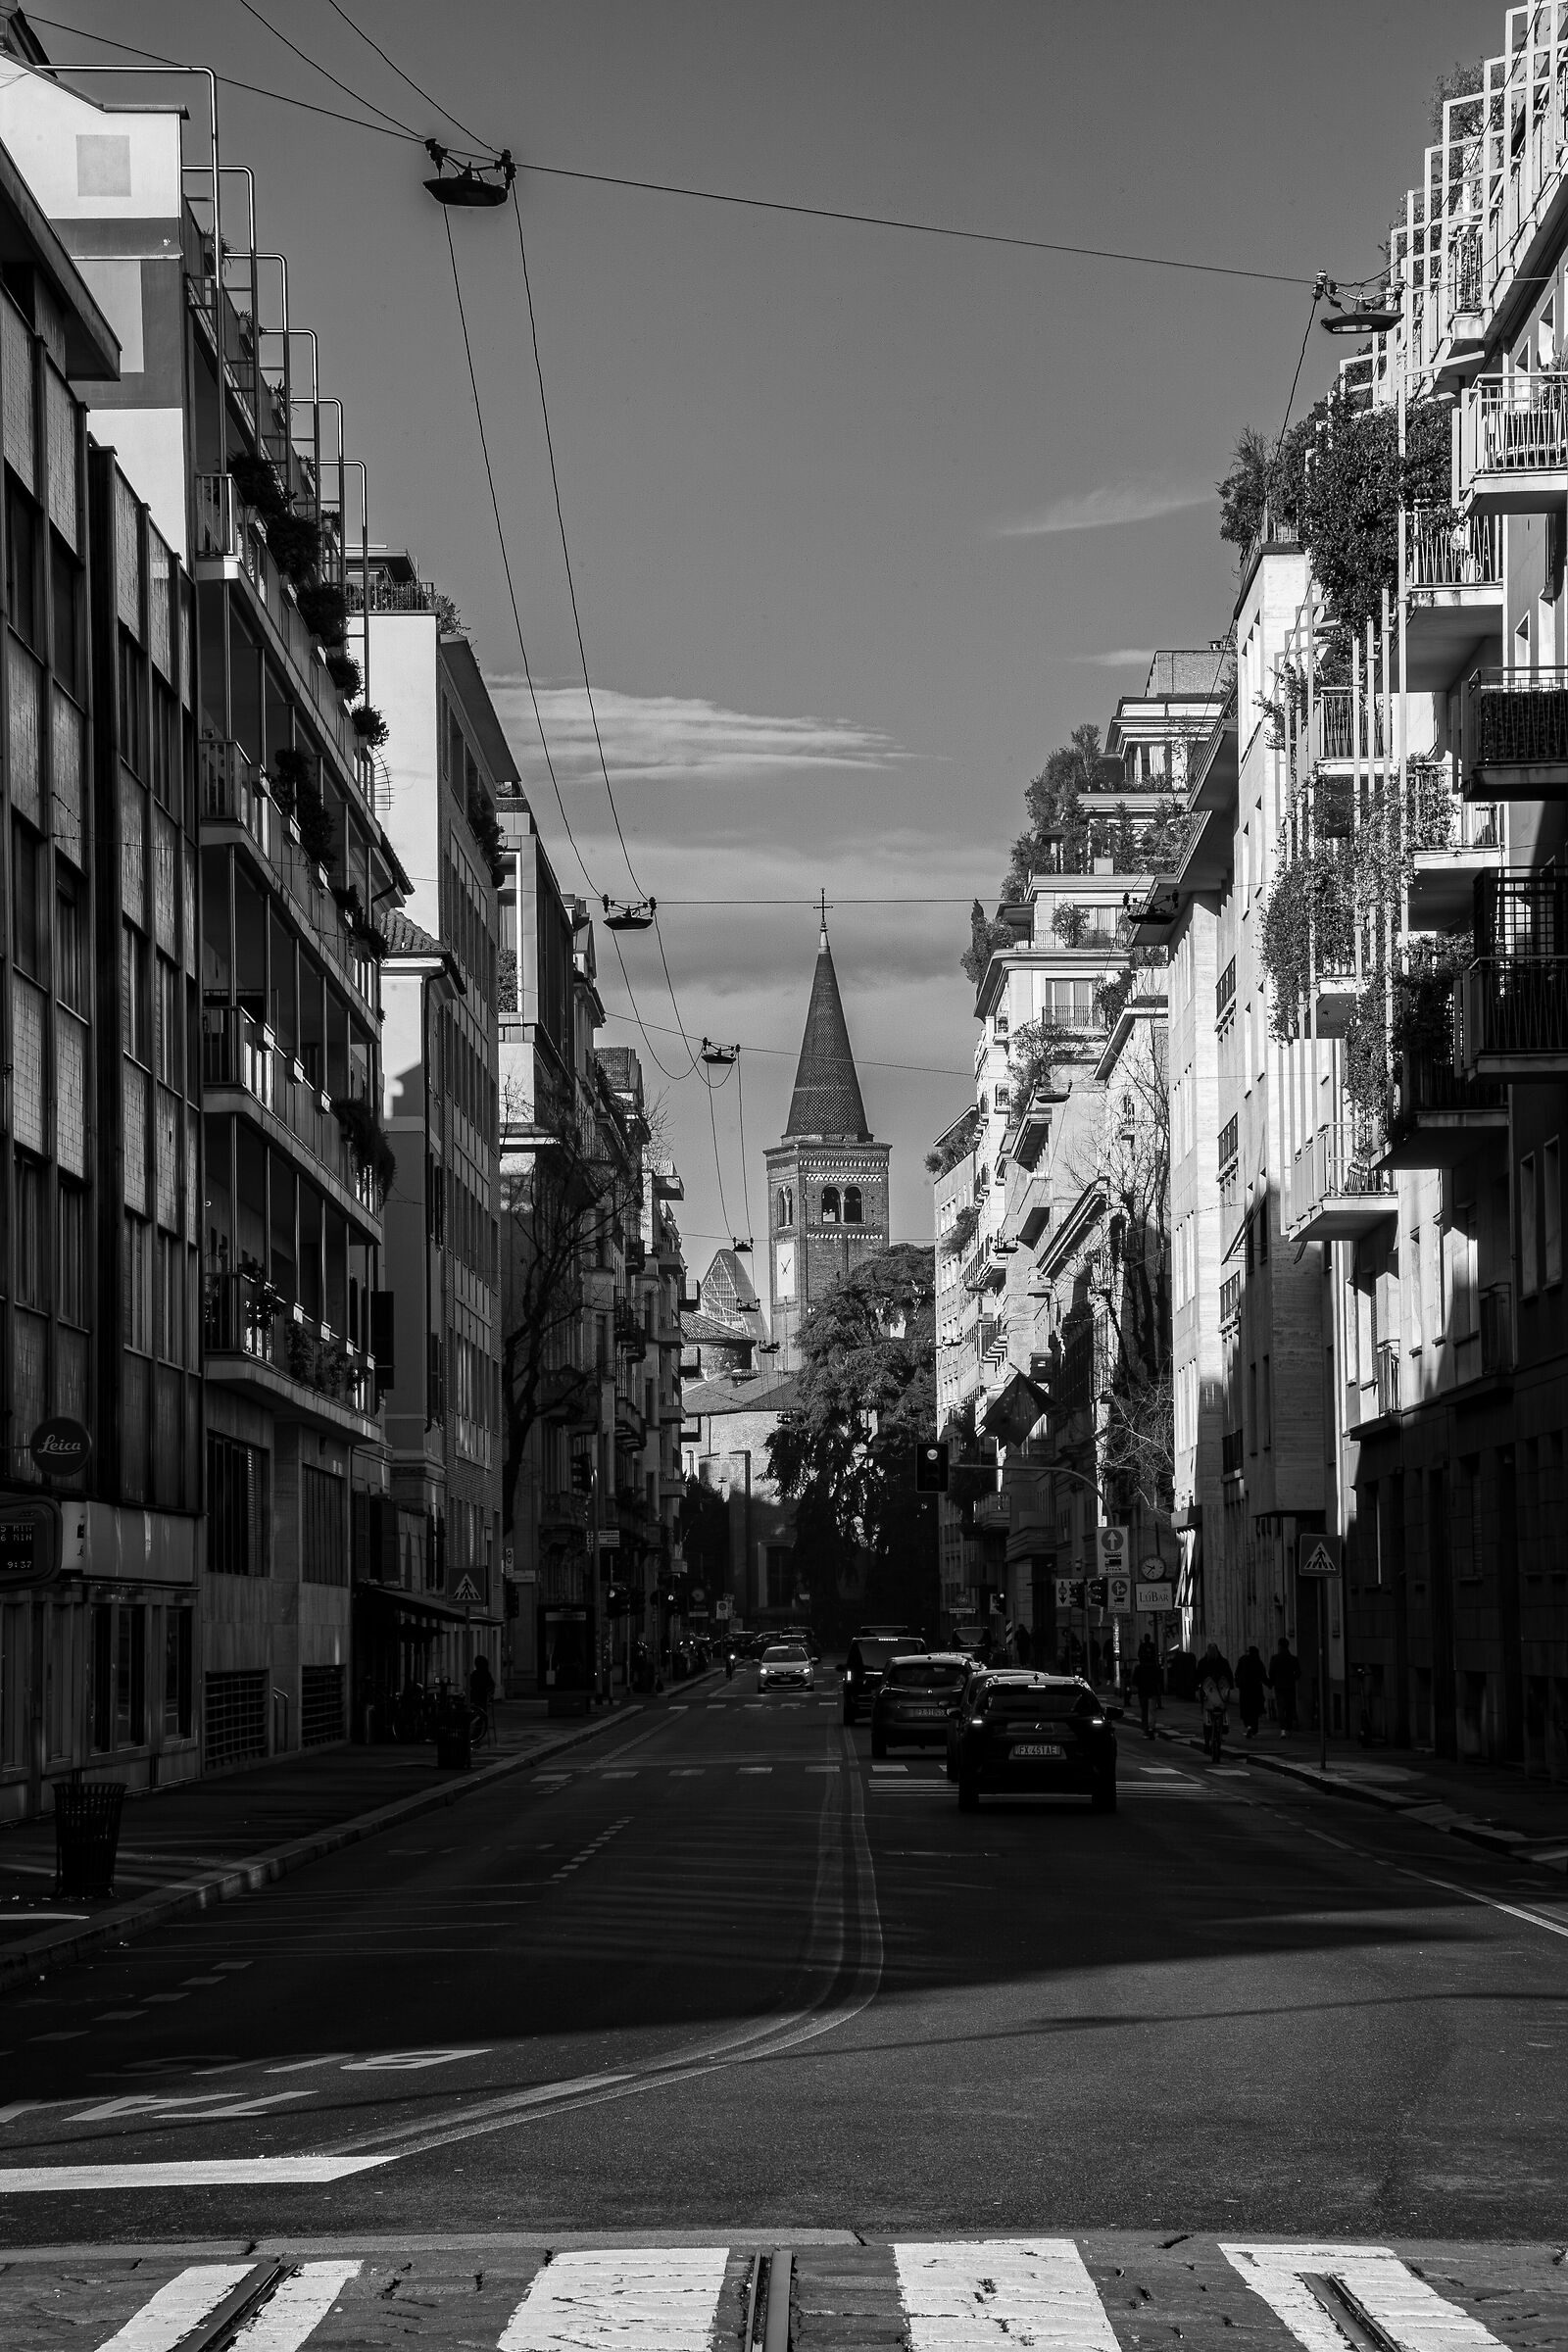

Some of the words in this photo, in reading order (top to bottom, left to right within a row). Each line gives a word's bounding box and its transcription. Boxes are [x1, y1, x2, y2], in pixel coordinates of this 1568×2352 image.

[37, 1434, 82, 1455] Leica
[13, 1533, 32, 1542] MIN
[7, 1560, 32, 1569] 9:37
[86, 2049, 495, 2079] BUS
[0, 2090, 319, 2123] TAX
